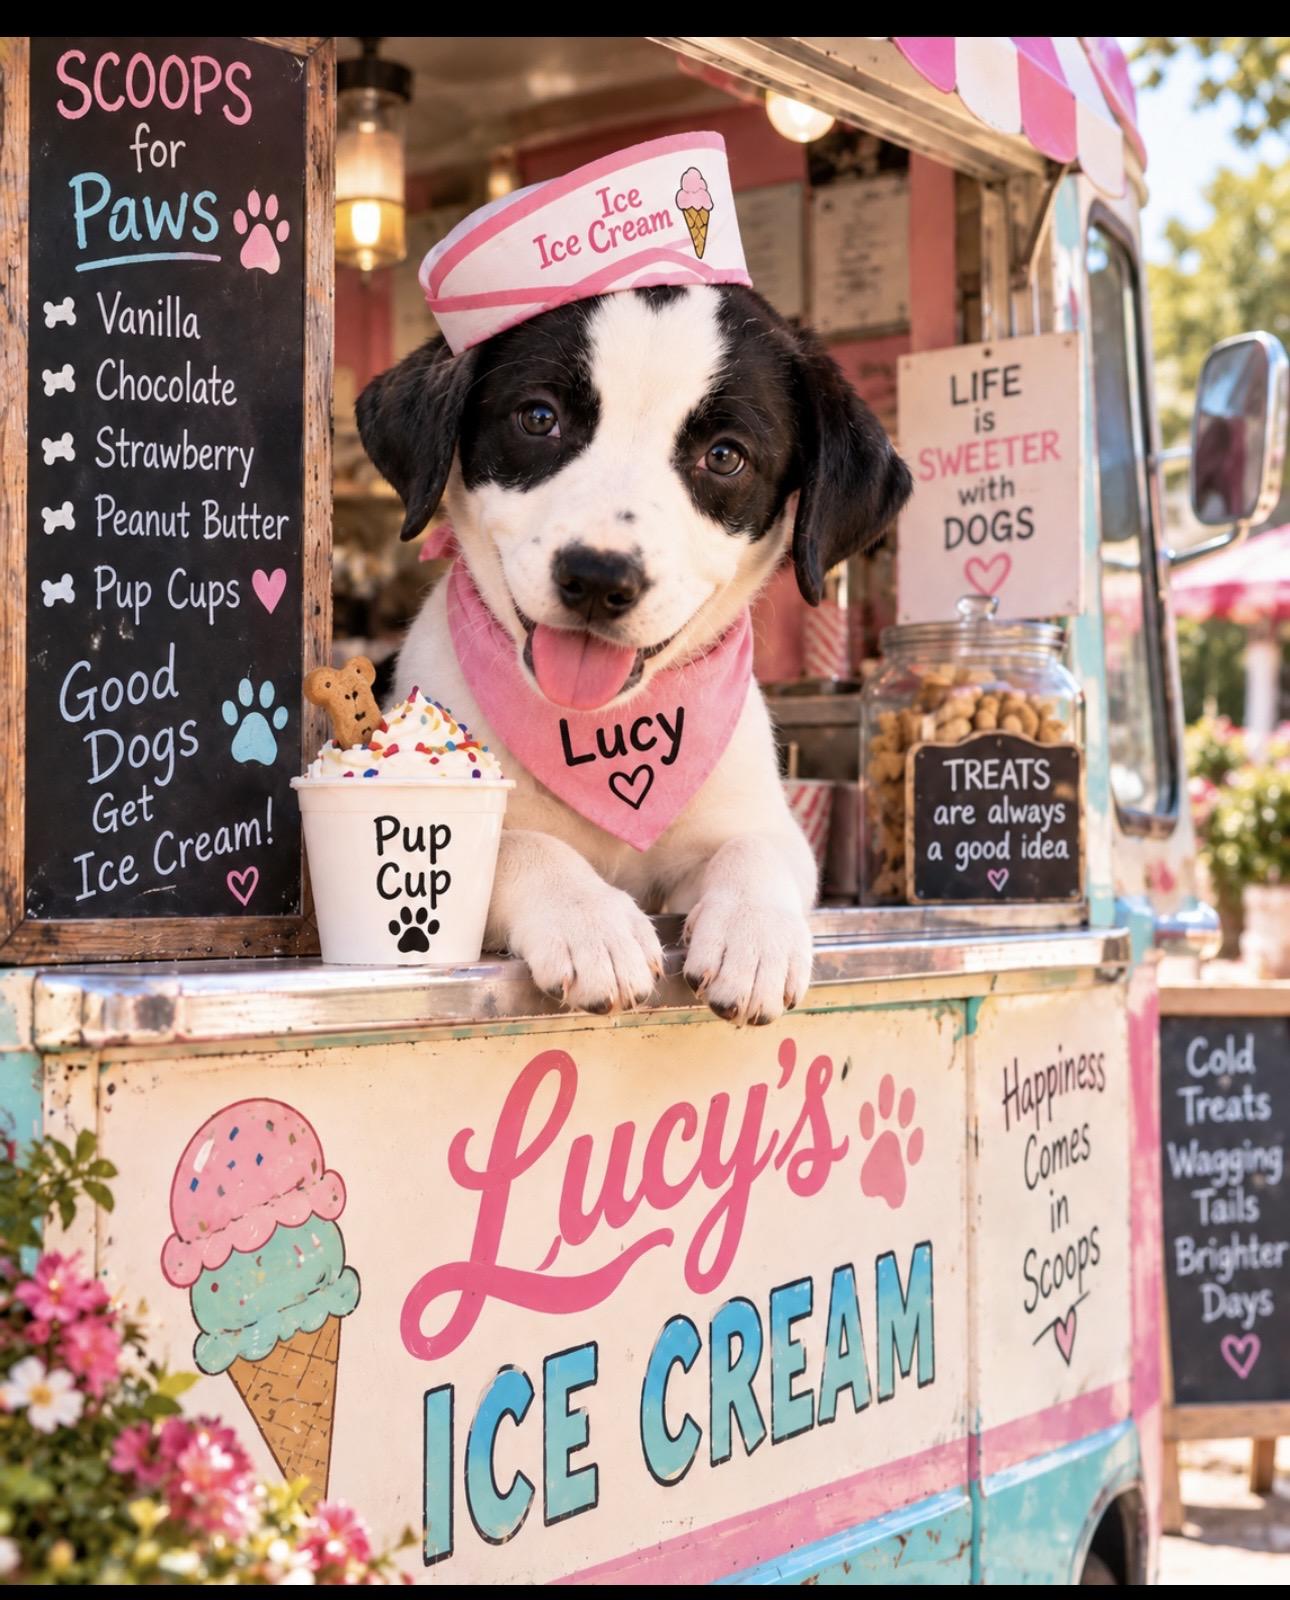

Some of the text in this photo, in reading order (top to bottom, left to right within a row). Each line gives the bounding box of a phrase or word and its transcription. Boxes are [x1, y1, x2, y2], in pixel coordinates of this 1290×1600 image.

[56, 49, 253, 125] SCOOPS
[129, 123, 186, 173] for
[68, 172, 219, 249] Paws
[595, 186, 643, 219] Ice
[532, 209, 673, 270] Ice Cream
[96, 290, 201, 340] Vanilla
[96, 358, 237, 406] Chocolate
[951, 364, 1022, 406] LIFE
[974, 408, 995, 433] is
[95, 425, 254, 488] Strawberry
[918, 430, 1062, 482] SWEETER
[958, 475, 1015, 506] with
[94, 493, 289, 540] Peanut Butter
[944, 506, 1035, 551] DOGS
[93, 565, 240, 626] Pup Cups
[59, 642, 179, 723] Good
[83, 720, 199, 786] Dogs
[559, 706, 685, 768] Lucy
[942, 758, 1051, 792] TREATS
[93, 785, 154, 833] Get
[933, 795, 1066, 832] are always
[73, 796, 274, 901] Ice Cream!
[373, 815, 452, 865] Pup
[927, 830, 1069, 872] a good idea
[376, 862, 452, 910] Cup
[1185, 1032, 1255, 1079] Cold
[1001, 1044, 1106, 1132] Happiness
[1177, 1085, 1272, 1126] Treats
[1024, 1122, 1091, 1191] Comes
[1167, 1139, 1284, 1187] Wagging
[400, 1038, 849, 1361] Lucy's
[1050, 1189, 1069, 1234] in
[1191, 1187, 1260, 1226] Tails
[1023, 1225, 1101, 1314] Scoops
[1174, 1231, 1289, 1284] Brighter
[1200, 1283, 1275, 1330] Days
[423, 1240, 936, 1567] ICE CREAM
